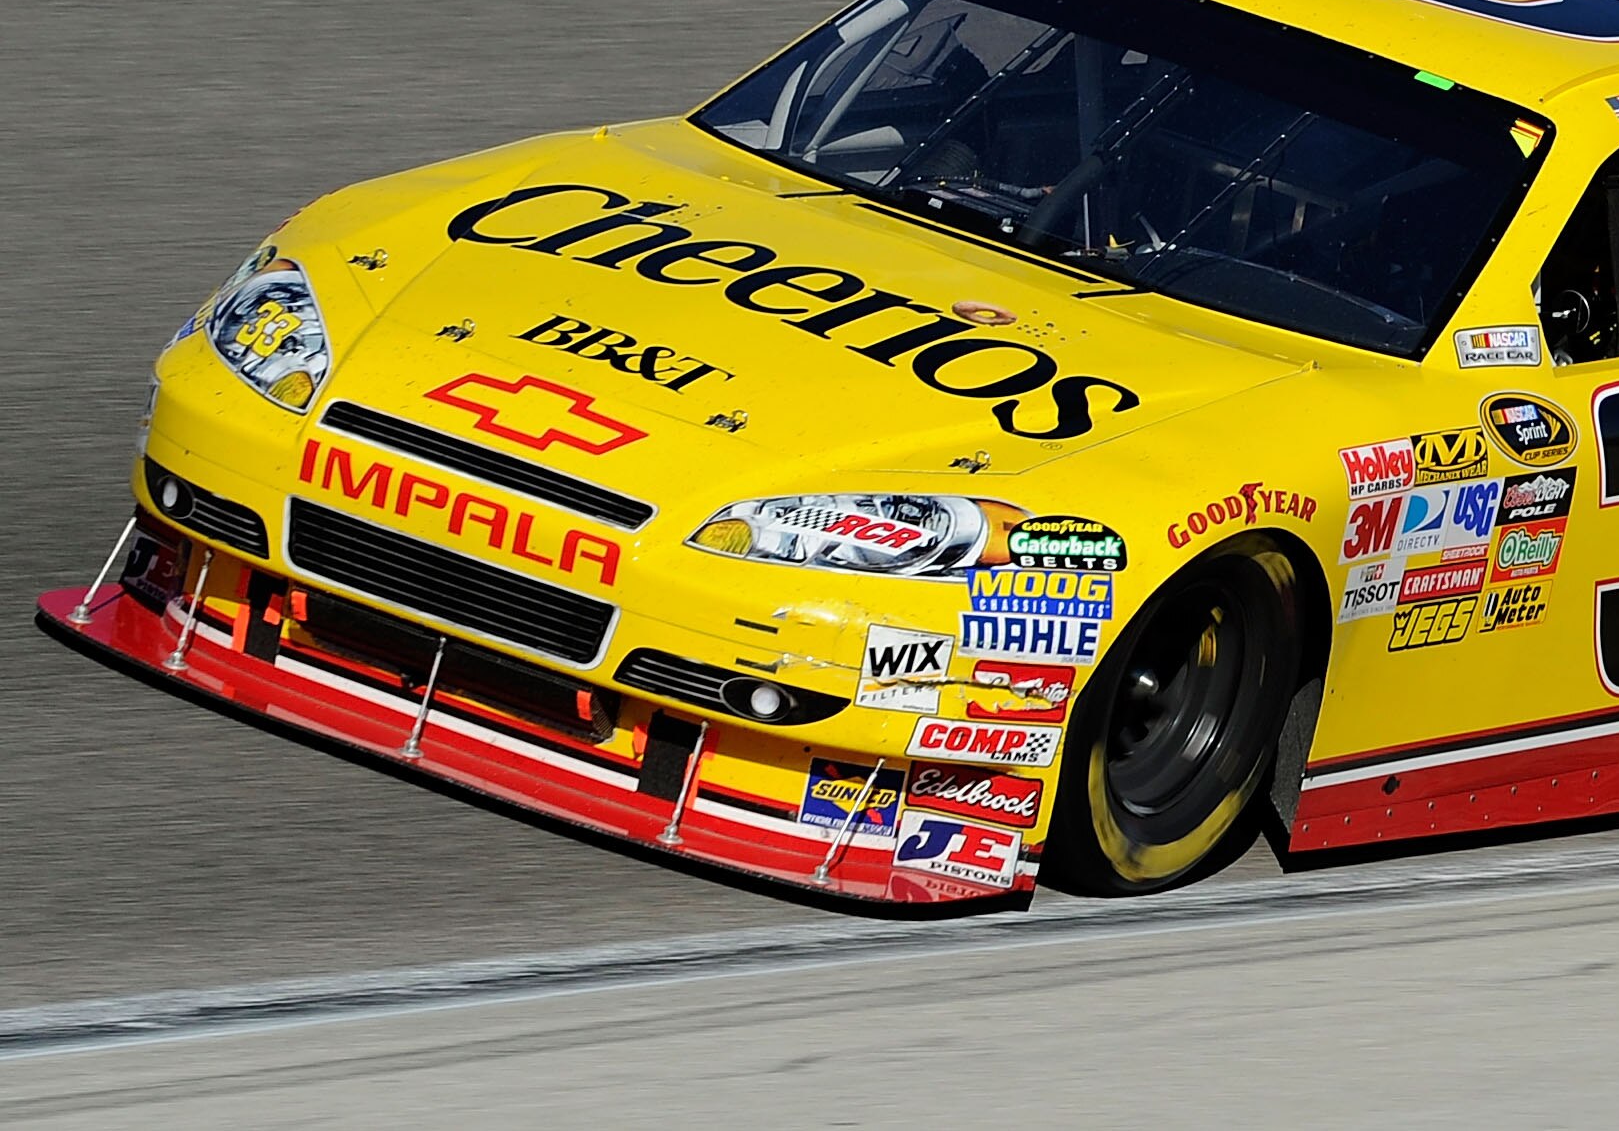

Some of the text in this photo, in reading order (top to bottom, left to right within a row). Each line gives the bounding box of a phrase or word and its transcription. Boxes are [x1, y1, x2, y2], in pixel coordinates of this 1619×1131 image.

[446, 183, 1141, 440] Cheerios
[236, 300, 302, 357] 33
[1488, 331, 1528, 347] NASCAR
[513, 313, 736, 394] BB&T
[1465, 350, 1535, 362] RACE CAR
[1516, 422, 1548, 445] Sprint
[1342, 446, 1414, 487] Holley
[1524, 447, 1568, 461] CUP SERIES
[1415, 460, 1487, 483] MECHANIX WEAR
[1351, 478, 1402, 496] HP CARBS
[1533, 481, 1570, 504] LIGHT
[299, 438, 621, 587] IMPALA
[1167, 481, 1317, 549] GOODYEAR
[1453, 481, 1499, 538] USG
[1509, 503, 1557, 519] POLE
[828, 512, 923, 550] RCR
[1021, 519, 1104, 534] GOODYEAR
[1344, 497, 1402, 559] 3M
[1009, 532, 1120, 557] Gatorback
[1499, 528, 1561, 568] O'Reilly
[1020, 555, 1118, 570] BELTS
[971, 570, 1111, 602] MOOG
[1344, 581, 1400, 609] TISSOT
[1403, 567, 1484, 595] CRAFTSMAN
[1501, 583, 1541, 607] Auto
[979, 599, 1105, 618] CHASSIS PARTS
[1496, 603, 1546, 625] Meter
[962, 613, 1098, 656] MAHLE
[1389, 597, 1478, 649] JEGS
[868, 640, 946, 677] WIX
[919, 722, 1027, 755] COMP
[990, 751, 1039, 763] CAMS
[911, 768, 1037, 817] Edelbrock
[898, 819, 1014, 870] JE
[930, 861, 1012, 886] PISTONS
